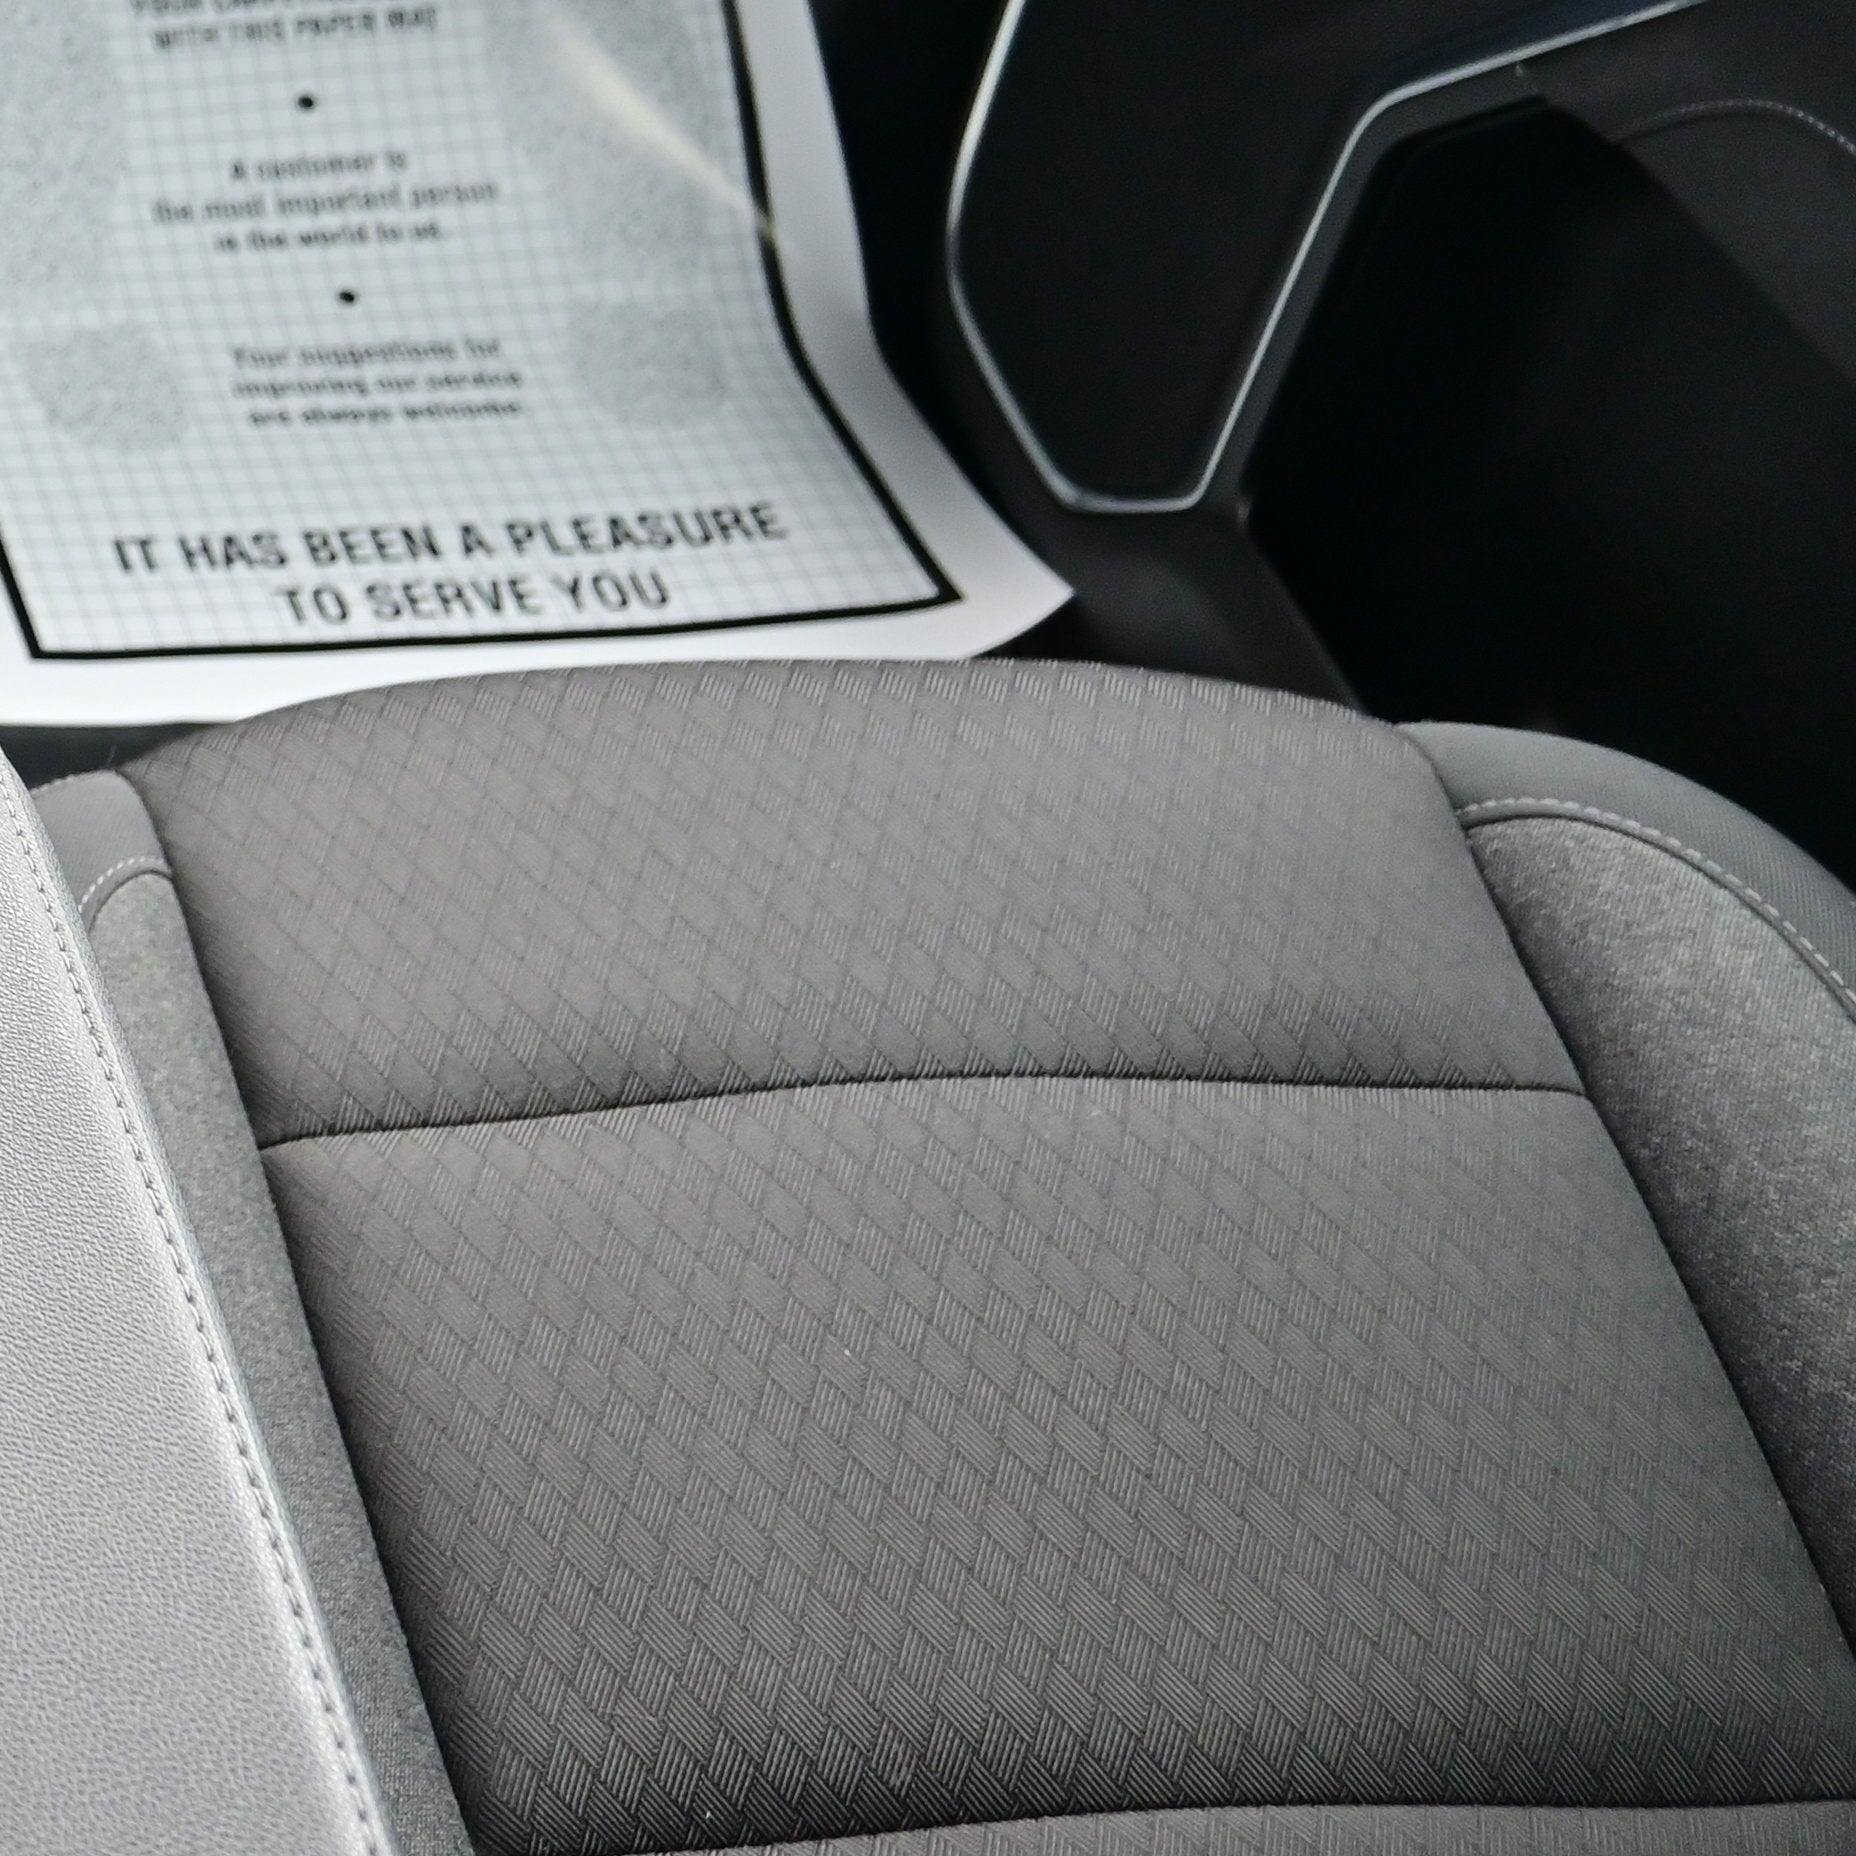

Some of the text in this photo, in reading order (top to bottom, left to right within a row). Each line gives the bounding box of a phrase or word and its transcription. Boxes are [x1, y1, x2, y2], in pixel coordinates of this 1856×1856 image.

[152, 24, 220, 50] WITH
[229, 16, 285, 43] THIS
[296, 9, 377, 38] PAPER
[231, 157, 246, 180] A
[257, 151, 375, 181] customer
[152, 180, 498, 223] the most important person
[246, 227, 287, 251] the
[298, 219, 370, 247] world
[375, 217, 403, 242] to
[233, 333, 501, 368] Your suggestions for
[231, 364, 523, 400] improving our service
[249, 405, 290, 428] are
[299, 400, 393, 428] always
[112, 499, 789, 574] IT HAS BEEN A PLEASURE
[277, 568, 673, 626] TO SERVE YOU
